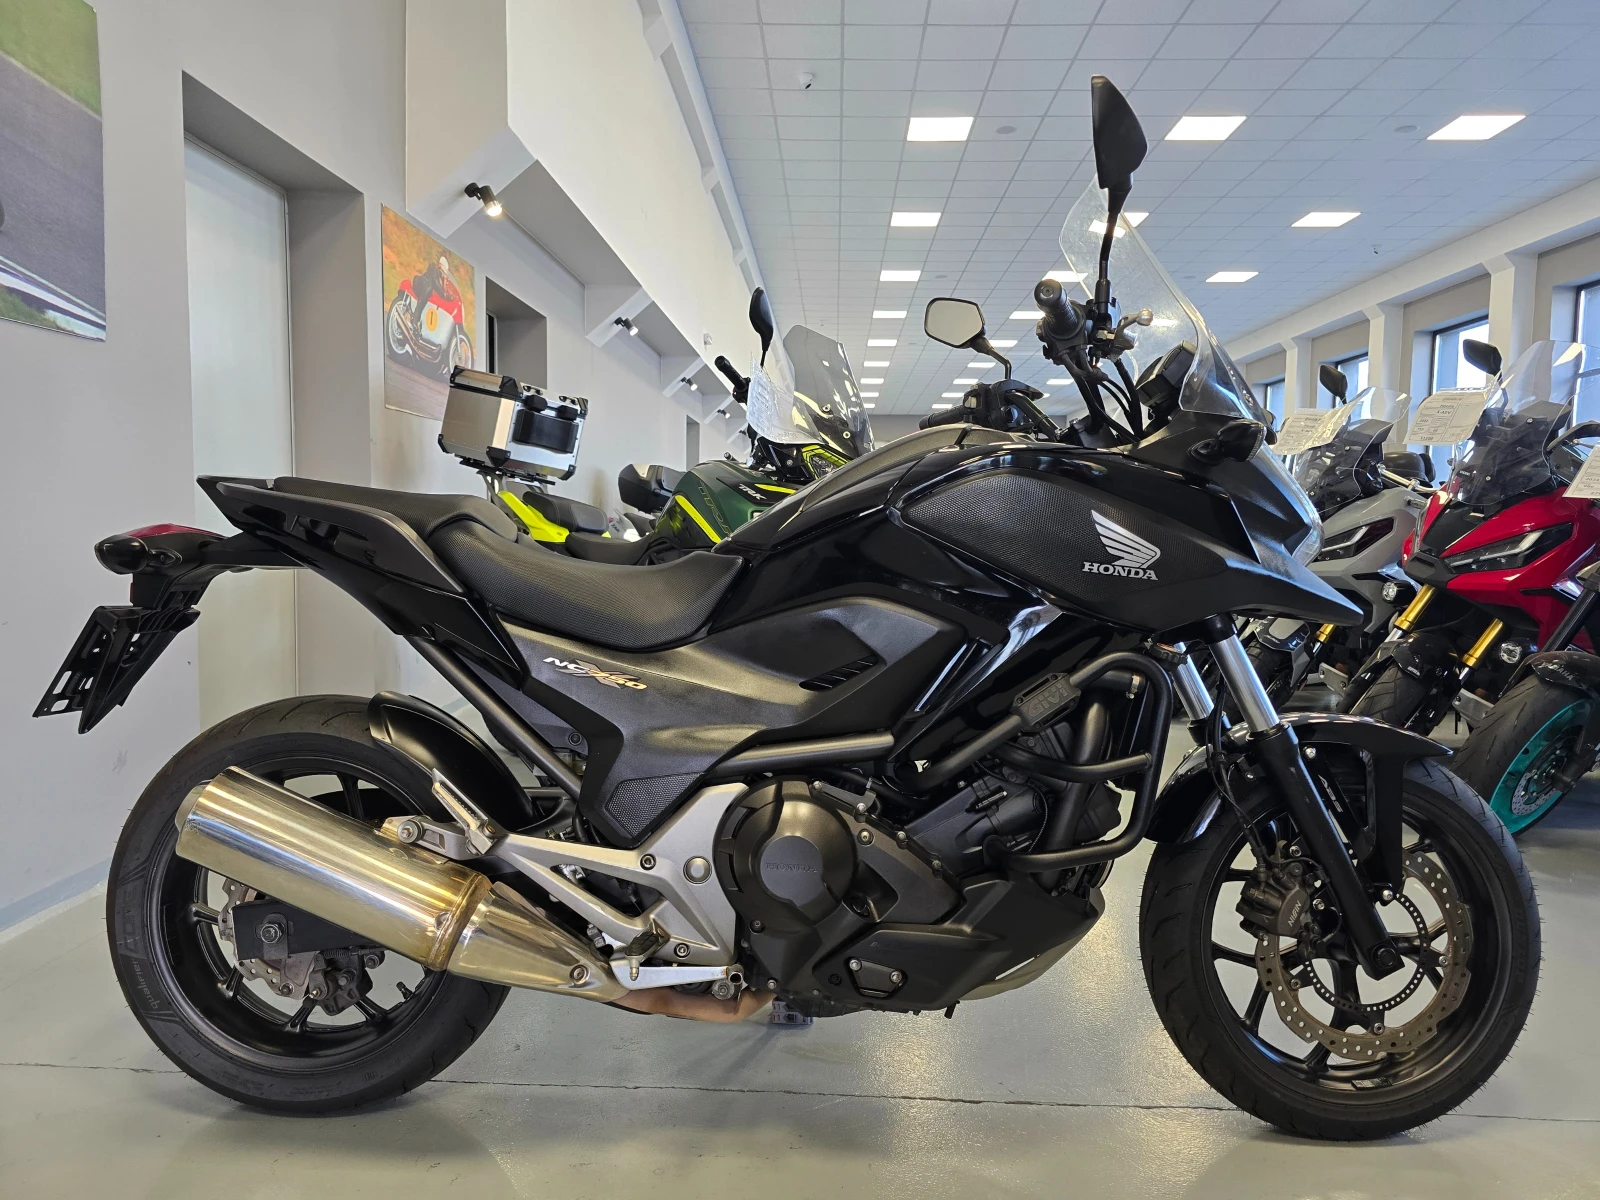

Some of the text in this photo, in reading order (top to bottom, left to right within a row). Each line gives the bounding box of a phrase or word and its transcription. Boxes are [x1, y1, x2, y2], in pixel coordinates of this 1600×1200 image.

[739, 483, 767, 500] TRK
[1082, 561, 1159, 581] HONDA
[1318, 774, 1344, 813] ABS
[765, 862, 818, 873] HONDA
